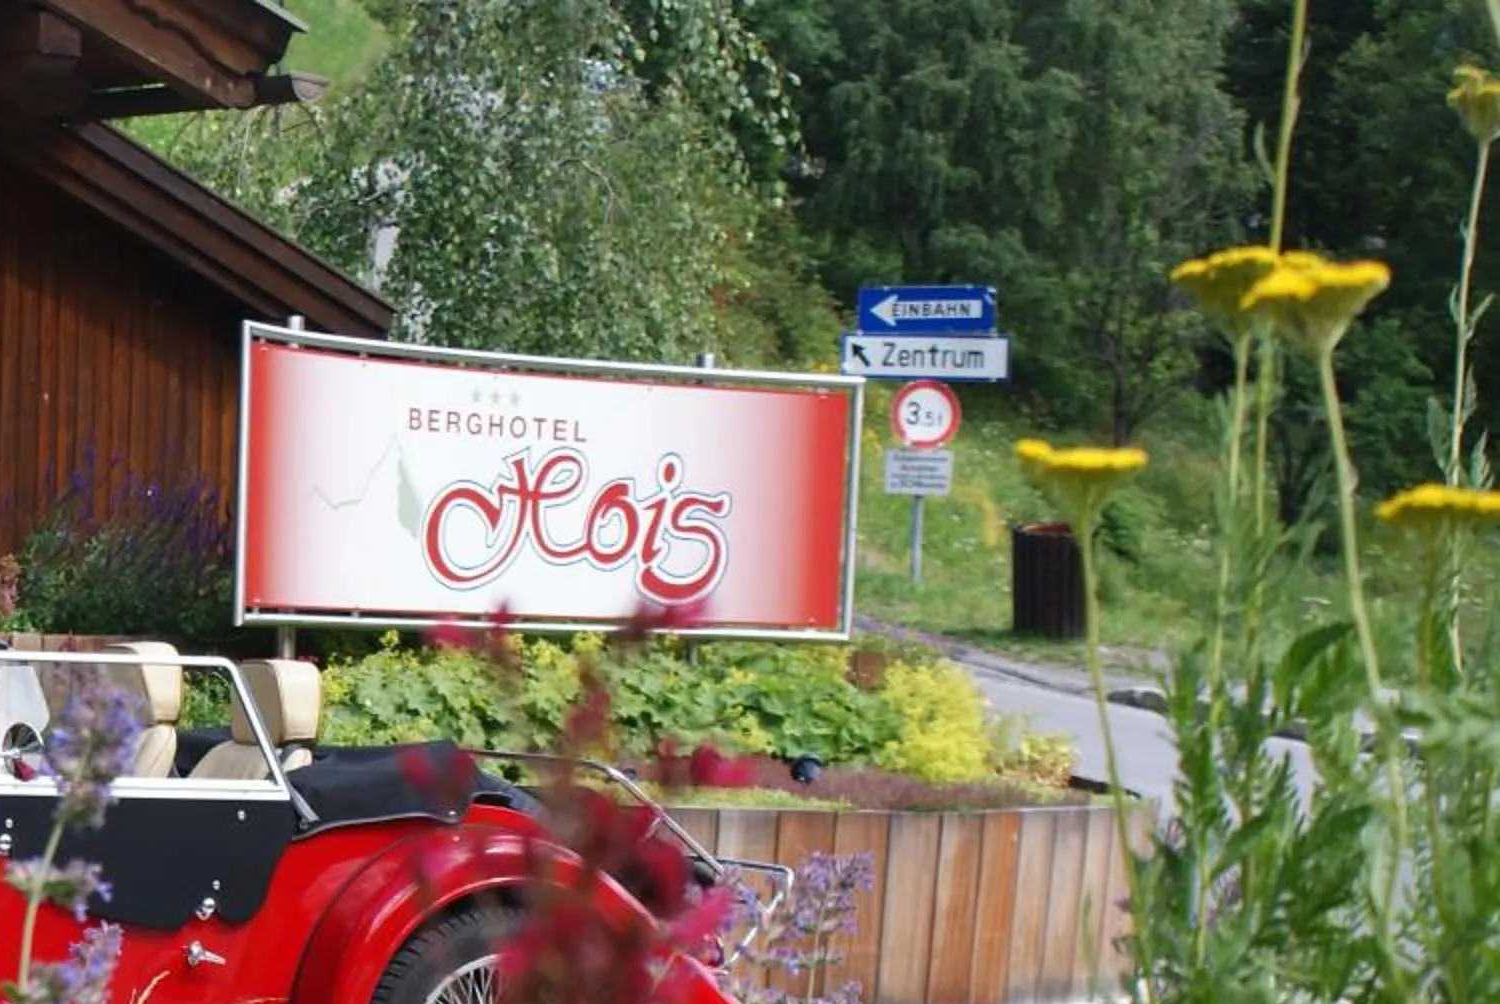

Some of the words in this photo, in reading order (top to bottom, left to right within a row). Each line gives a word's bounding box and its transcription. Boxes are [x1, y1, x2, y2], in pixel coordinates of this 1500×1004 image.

[892, 302, 971, 317] EINBAHN
[881, 341, 985, 369] Zentrum
[408, 407, 588, 444] BERGHOTEL
[424, 448, 731, 605] Hois
